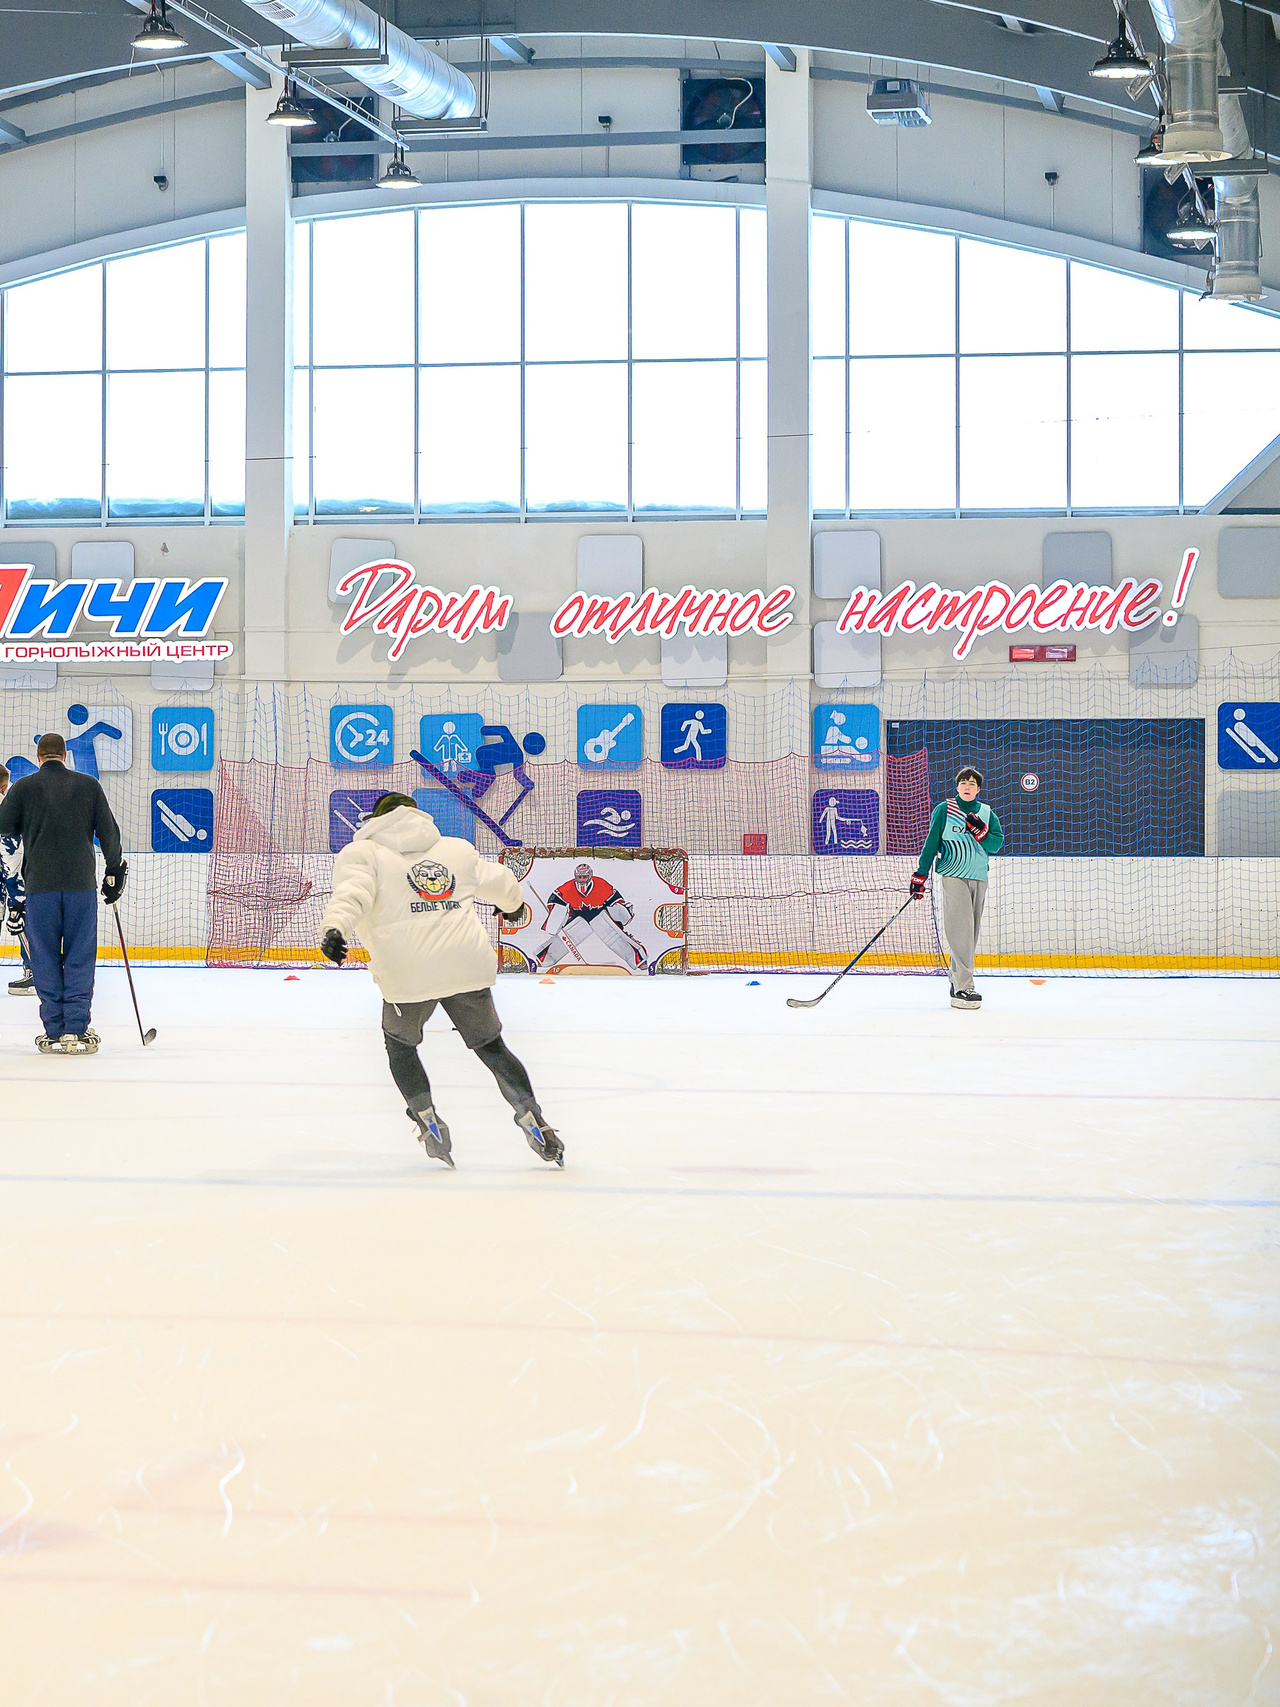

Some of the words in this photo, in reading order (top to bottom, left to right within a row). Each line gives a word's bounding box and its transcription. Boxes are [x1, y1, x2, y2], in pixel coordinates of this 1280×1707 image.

[339, 562, 509, 658] Дарим
[551, 588, 792, 640] отличное
[5, 643, 162, 659] ГОРНОЛЫЖНЫЙ
[166, 644, 229, 662] ЦЕНТР
[365, 729, 390, 746] 24
[410, 901, 439, 913] БЕЛЫЕ
[565, 940, 581, 962] CANADA
